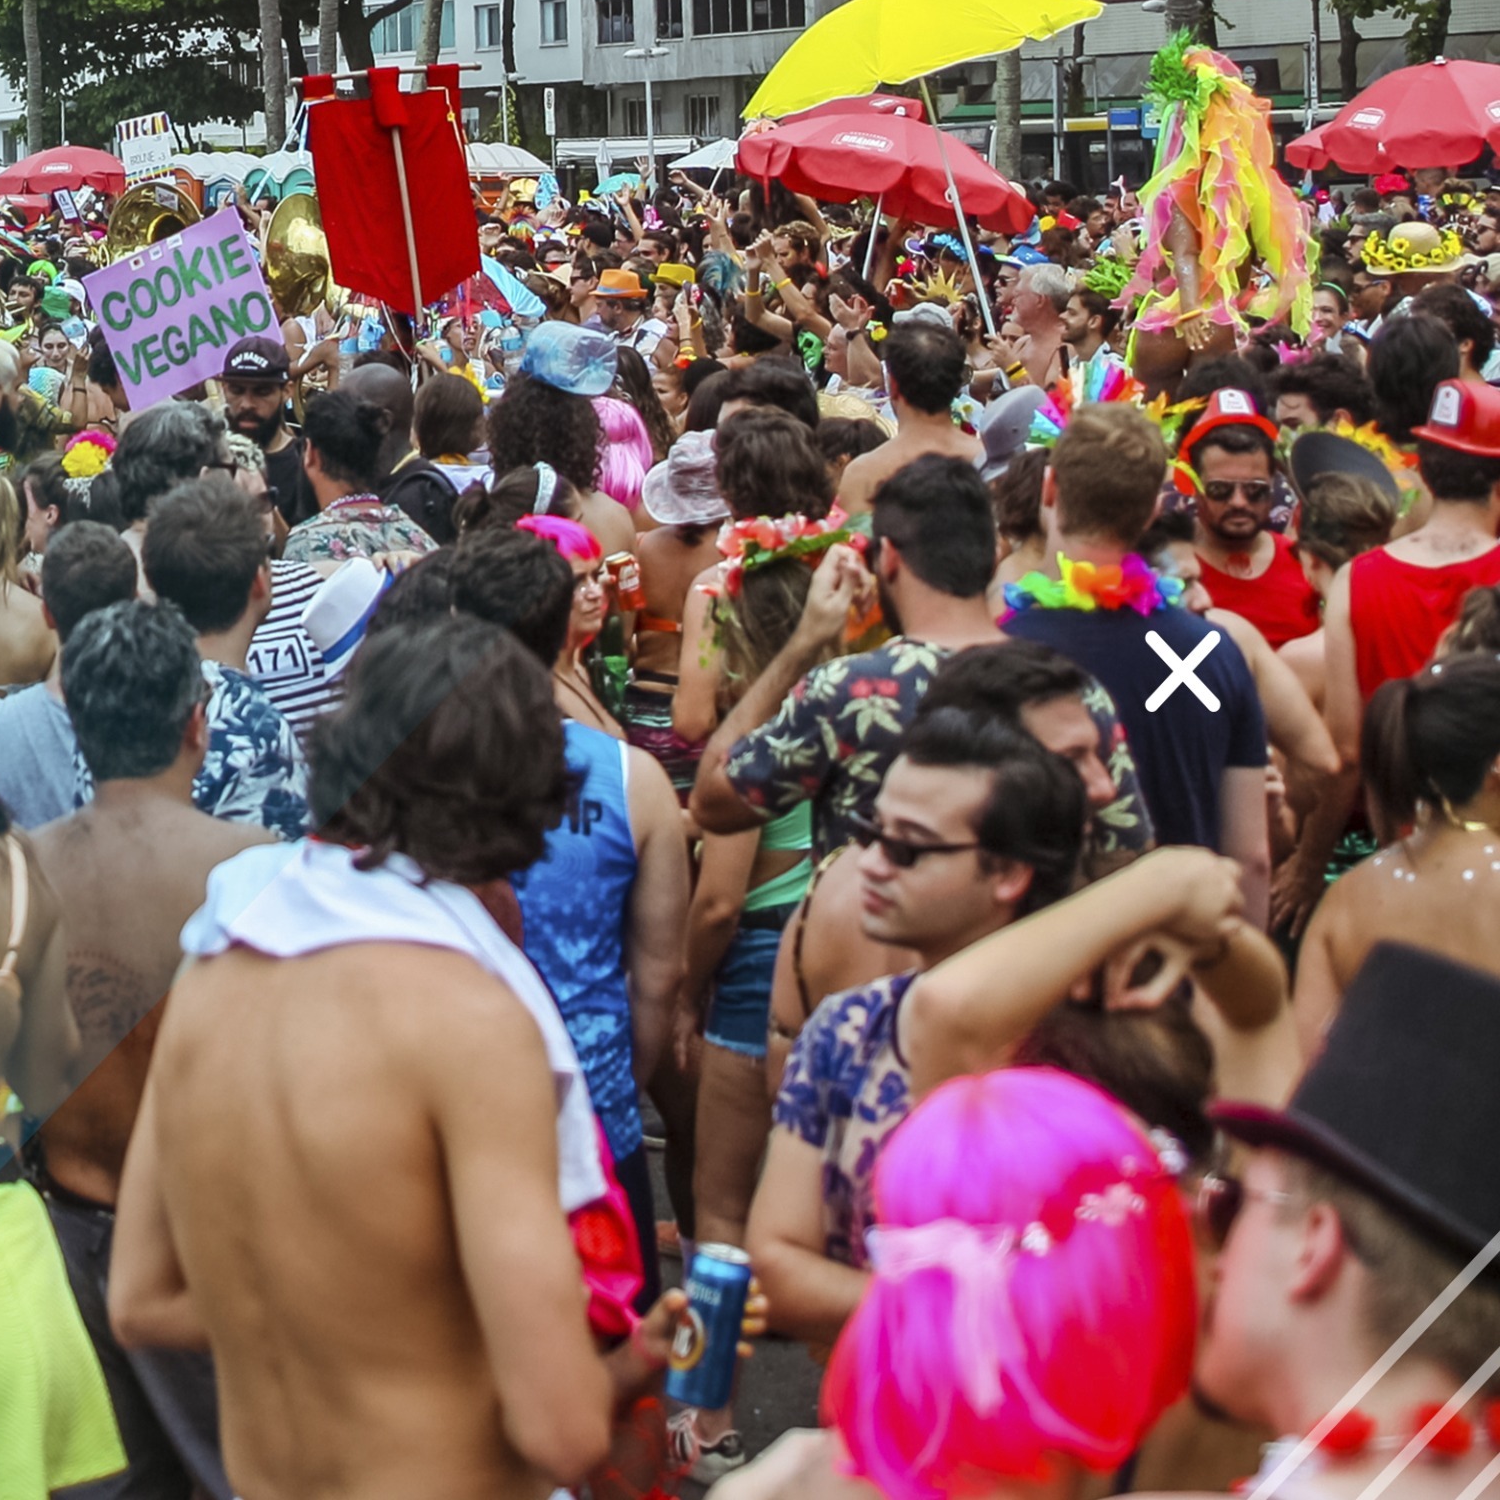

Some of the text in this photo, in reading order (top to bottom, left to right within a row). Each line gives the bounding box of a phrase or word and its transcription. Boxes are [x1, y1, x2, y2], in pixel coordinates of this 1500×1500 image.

[101, 234, 252, 331] COOKIE
[114, 291, 272, 386] VEGANO
[248, 644, 299, 674] 171
